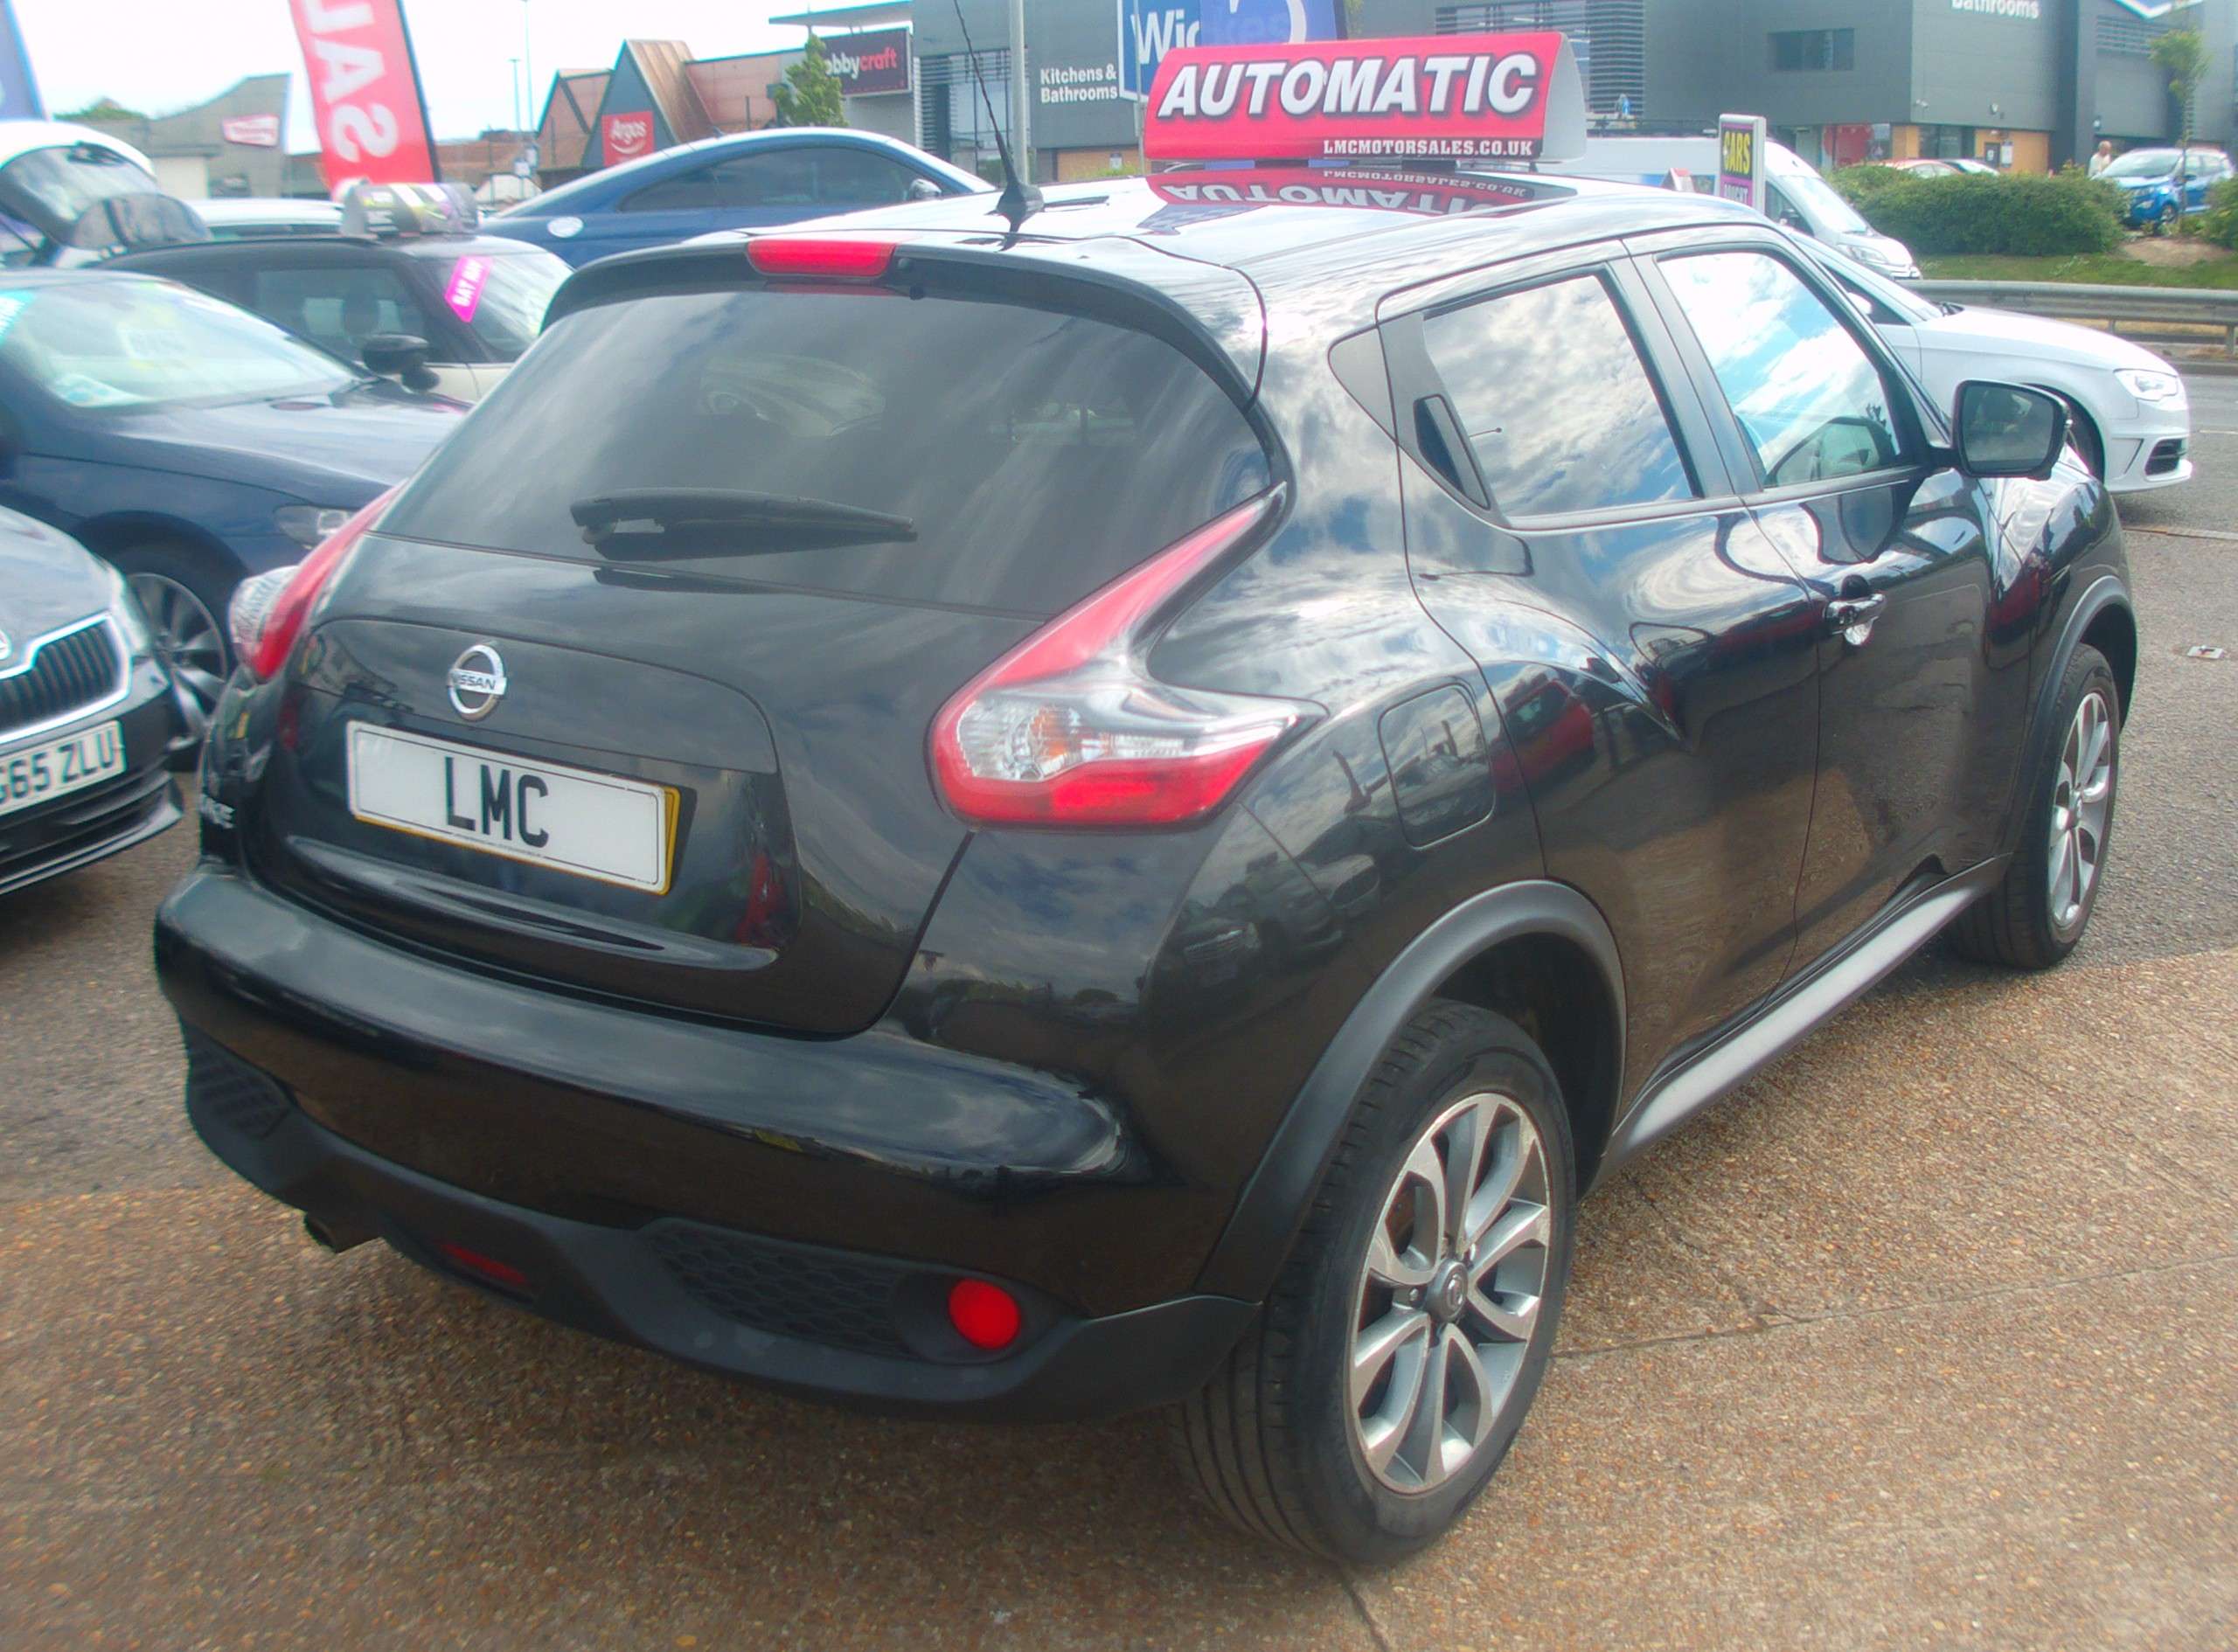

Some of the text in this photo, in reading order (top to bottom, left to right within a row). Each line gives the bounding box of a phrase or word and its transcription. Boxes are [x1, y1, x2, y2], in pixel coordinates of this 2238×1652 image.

[824, 46, 897, 80] obbycraft
[1040, 63, 1117, 84] Kitchens &
[1040, 86, 1118, 103] Bathrooms
[1157, 53, 1537, 117] AUTOMATIC
[1324, 139, 1533, 156] LMCMOTORSALES.CO.UK
[1723, 131, 1751, 175] CARS
[58, 730, 115, 783] ZLU
[444, 756, 550, 849] LMC
